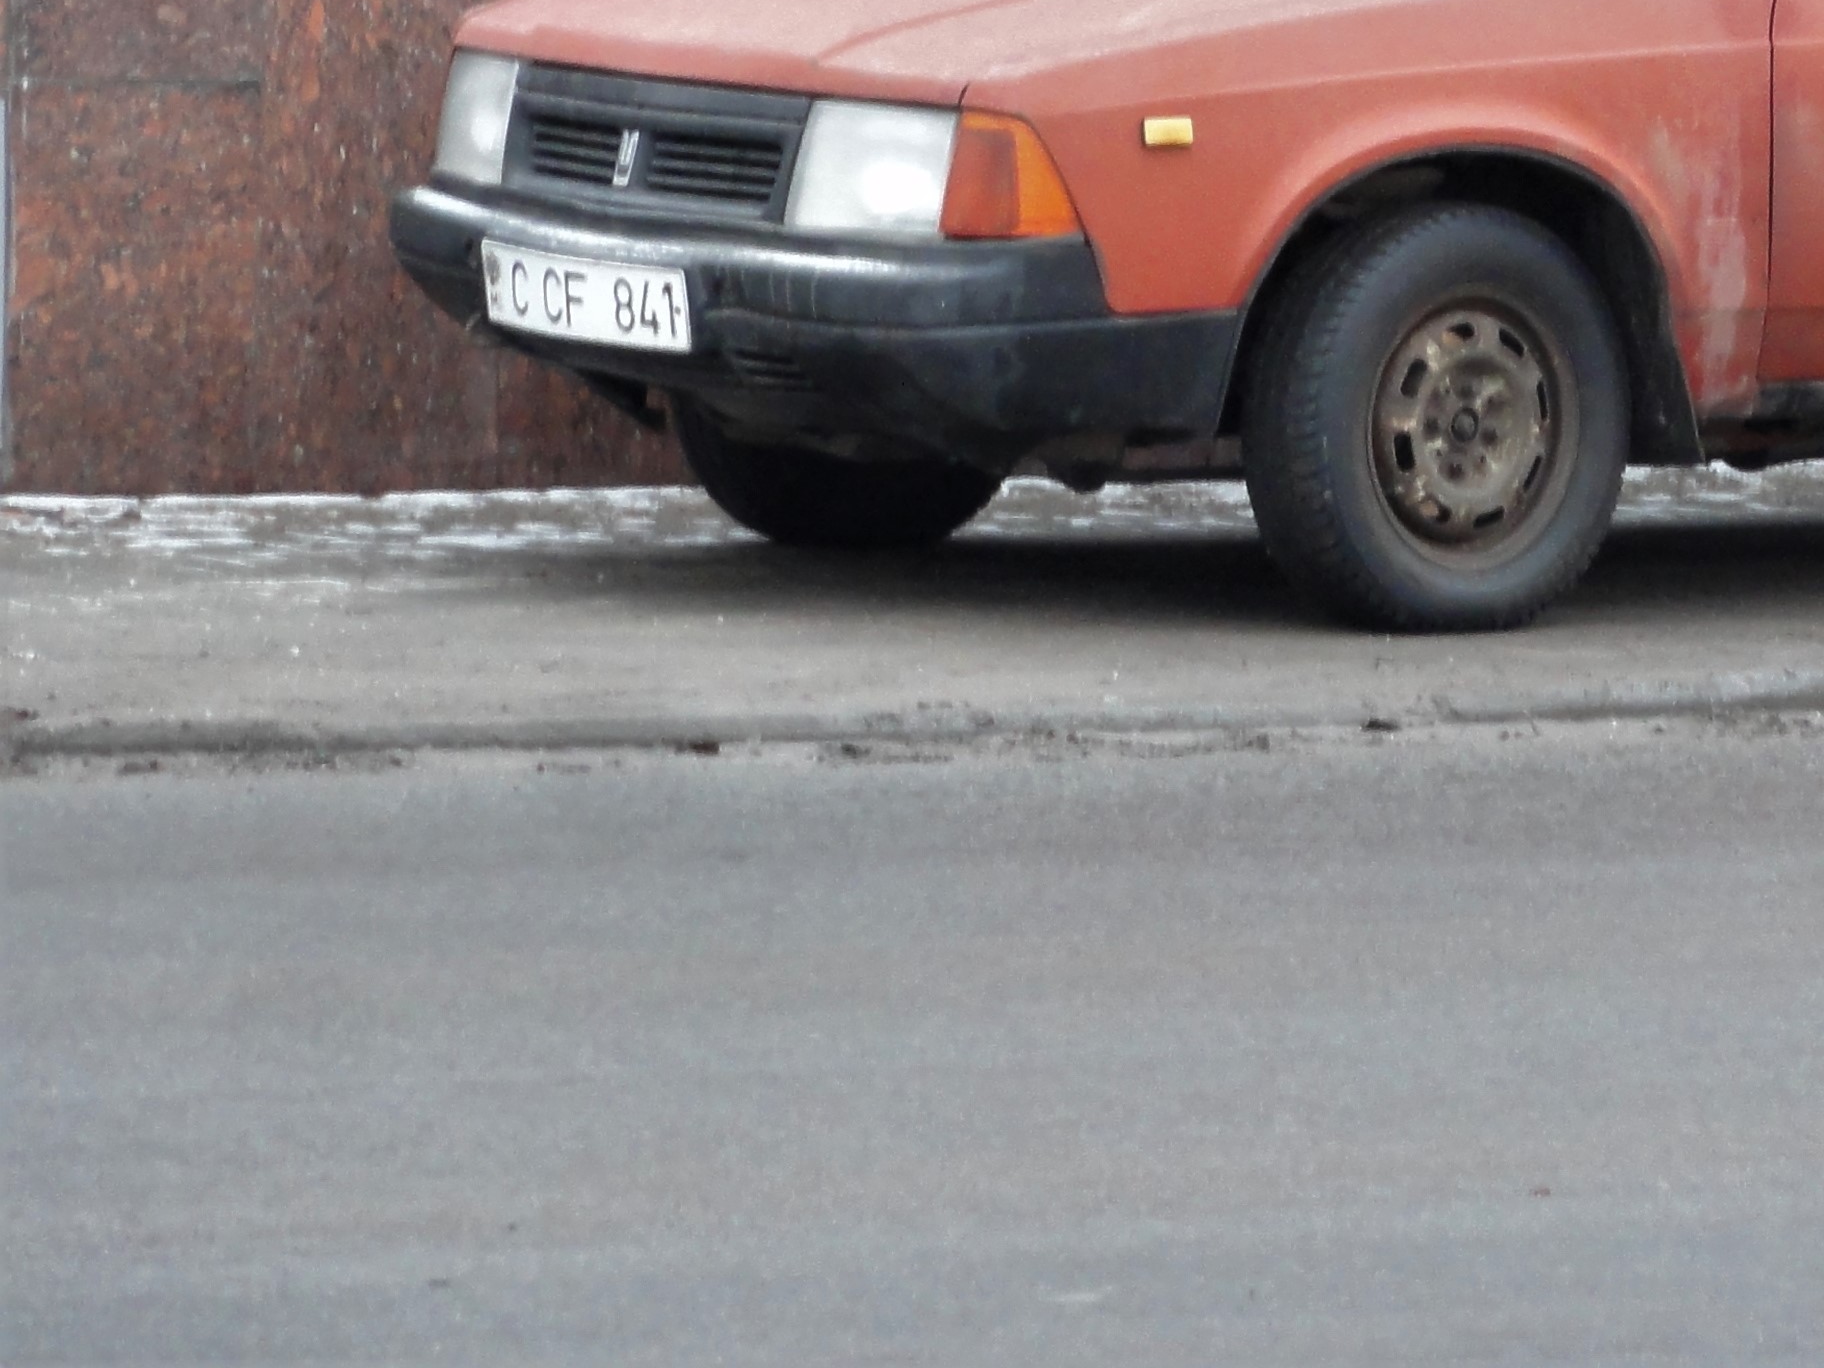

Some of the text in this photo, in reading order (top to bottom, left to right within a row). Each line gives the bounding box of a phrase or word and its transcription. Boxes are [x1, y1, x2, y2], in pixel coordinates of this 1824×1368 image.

[511, 259, 677, 339] C CF 841
